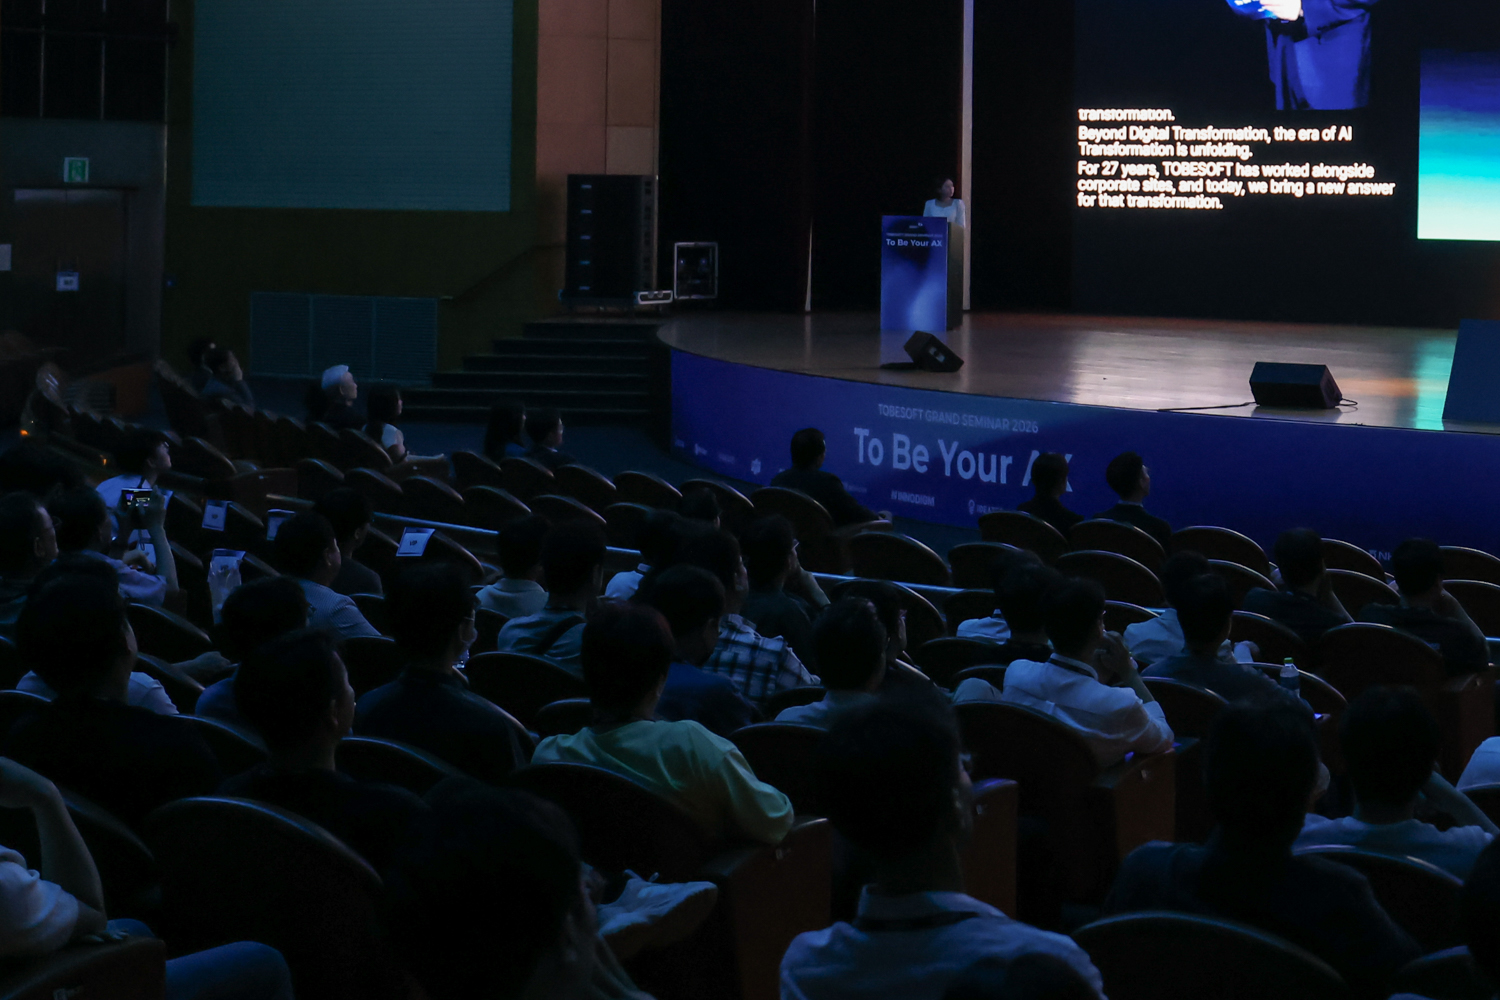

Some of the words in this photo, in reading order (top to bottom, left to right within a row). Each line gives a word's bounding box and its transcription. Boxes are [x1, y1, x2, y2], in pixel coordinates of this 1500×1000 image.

[1078, 108, 1175, 121] transformation.
[1078, 125, 1127, 143] Beyond
[1128, 125, 1170, 143] Digital
[1171, 125, 1271, 144] Transformation,
[1273, 125, 1296, 141] the
[1298, 128, 1320, 141] era
[1321, 125, 1337, 141] of
[1338, 126, 1353, 141] AI
[1078, 141, 1174, 157] Transformation
[1176, 142, 1188, 157] is
[1190, 142, 1253, 160] unfolding.
[1077, 160, 1100, 176] For
[1101, 160, 1119, 176] 27
[1120, 162, 1160, 179] years,
[1162, 161, 1234, 176] TOBESOFT
[1235, 162, 1260, 177] has
[1261, 162, 1310, 178] worked
[1311, 162, 1375, 181] alongside
[1077, 178, 1141, 194] corporate
[1141, 177, 1176, 195] sites,
[1178, 178, 1203, 193] and
[1205, 178, 1245, 196] today,
[1247, 180, 1268, 193] we
[1269, 178, 1304, 198] bring
[1305, 181, 1315, 194] a
[1317, 181, 1345, 195] new
[1347, 181, 1396, 195] answer
[1077, 192, 1097, 207] for
[1098, 192, 1125, 207] that
[1126, 193, 1223, 209] transformation.
[878, 403, 923, 420] TOBESOFT
[925, 410, 960, 425] GRAND
[962, 414, 1010, 430] SEMINAR
[1012, 419, 1038, 434] 2026
[854, 427, 884, 466] To
[892, 433, 930, 473] Be
[937, 439, 1013, 484] Your
